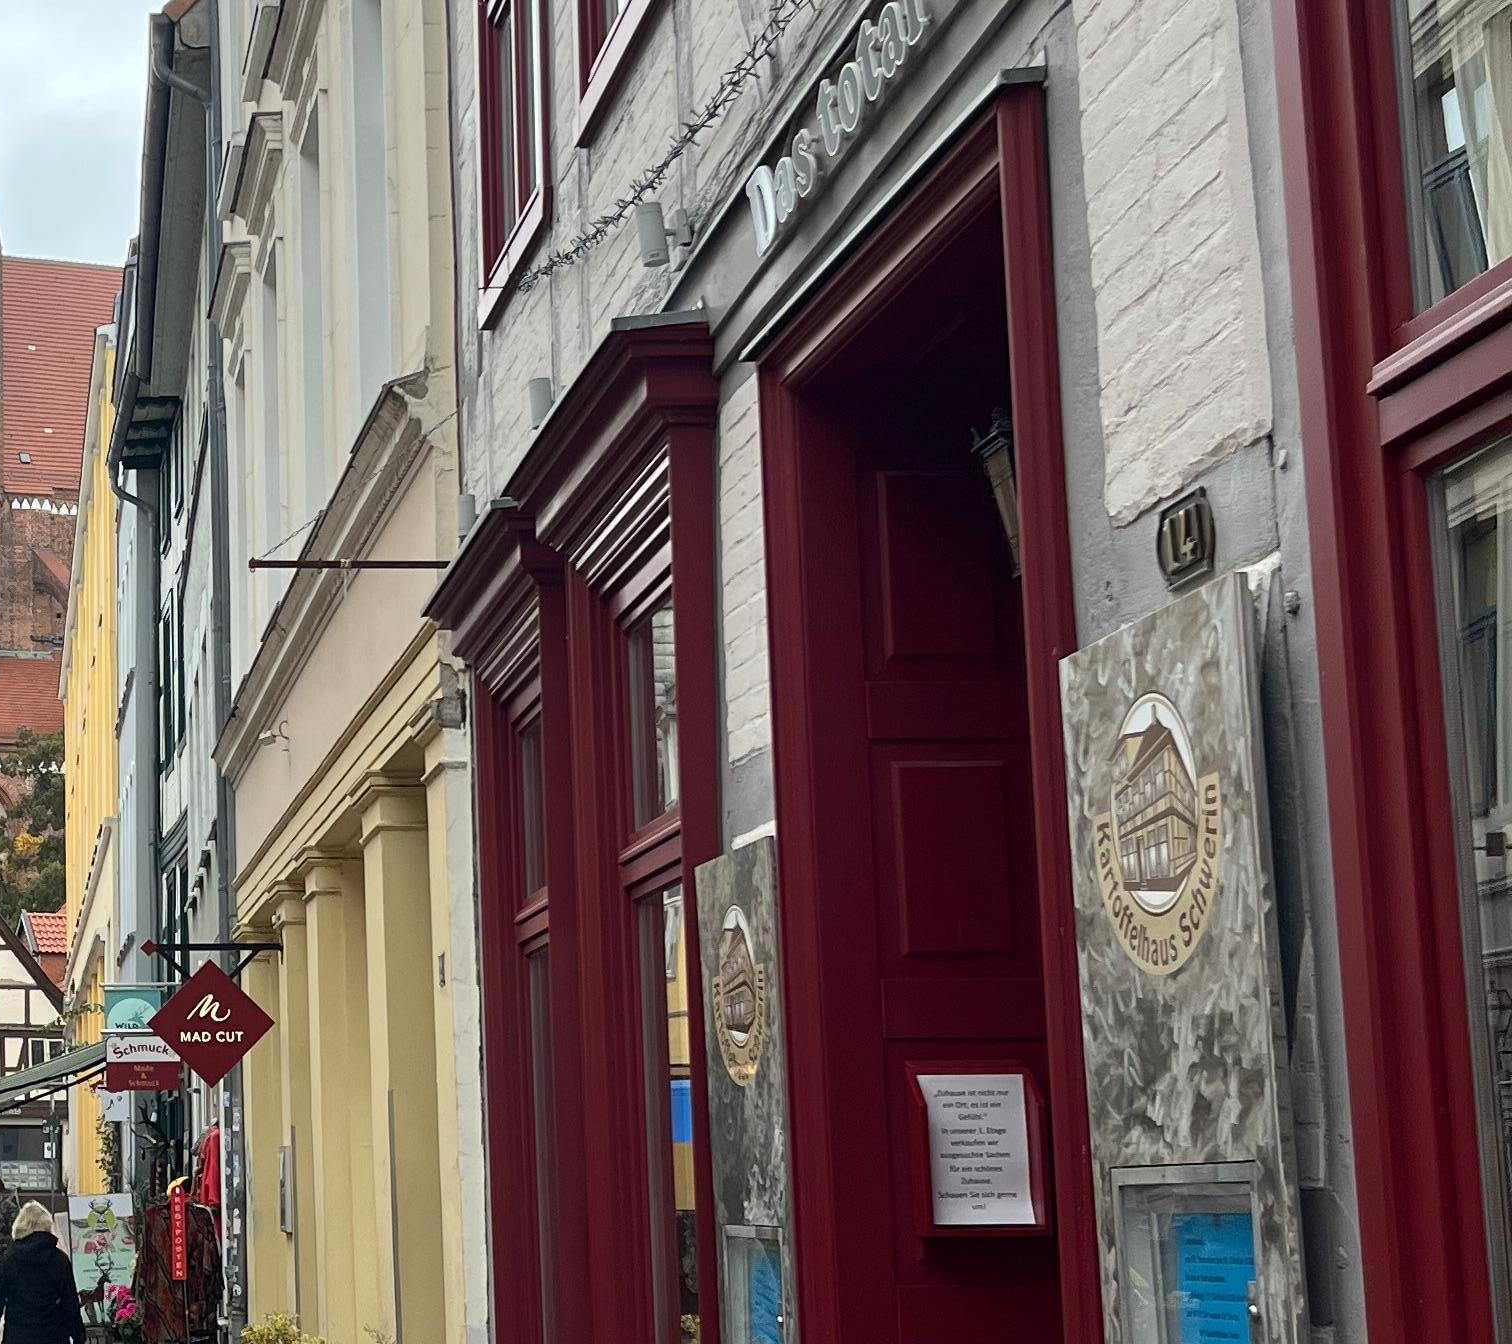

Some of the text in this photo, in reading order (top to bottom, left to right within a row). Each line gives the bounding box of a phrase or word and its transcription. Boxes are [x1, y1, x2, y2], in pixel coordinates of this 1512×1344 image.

[745, 128, 818, 257] Das
[1096, 783, 1217, 967] Kartoffelhaus Schwerin
[113, 1043, 170, 1059] Schmuck
[180, 1031, 245, 1043] MAD CUT
